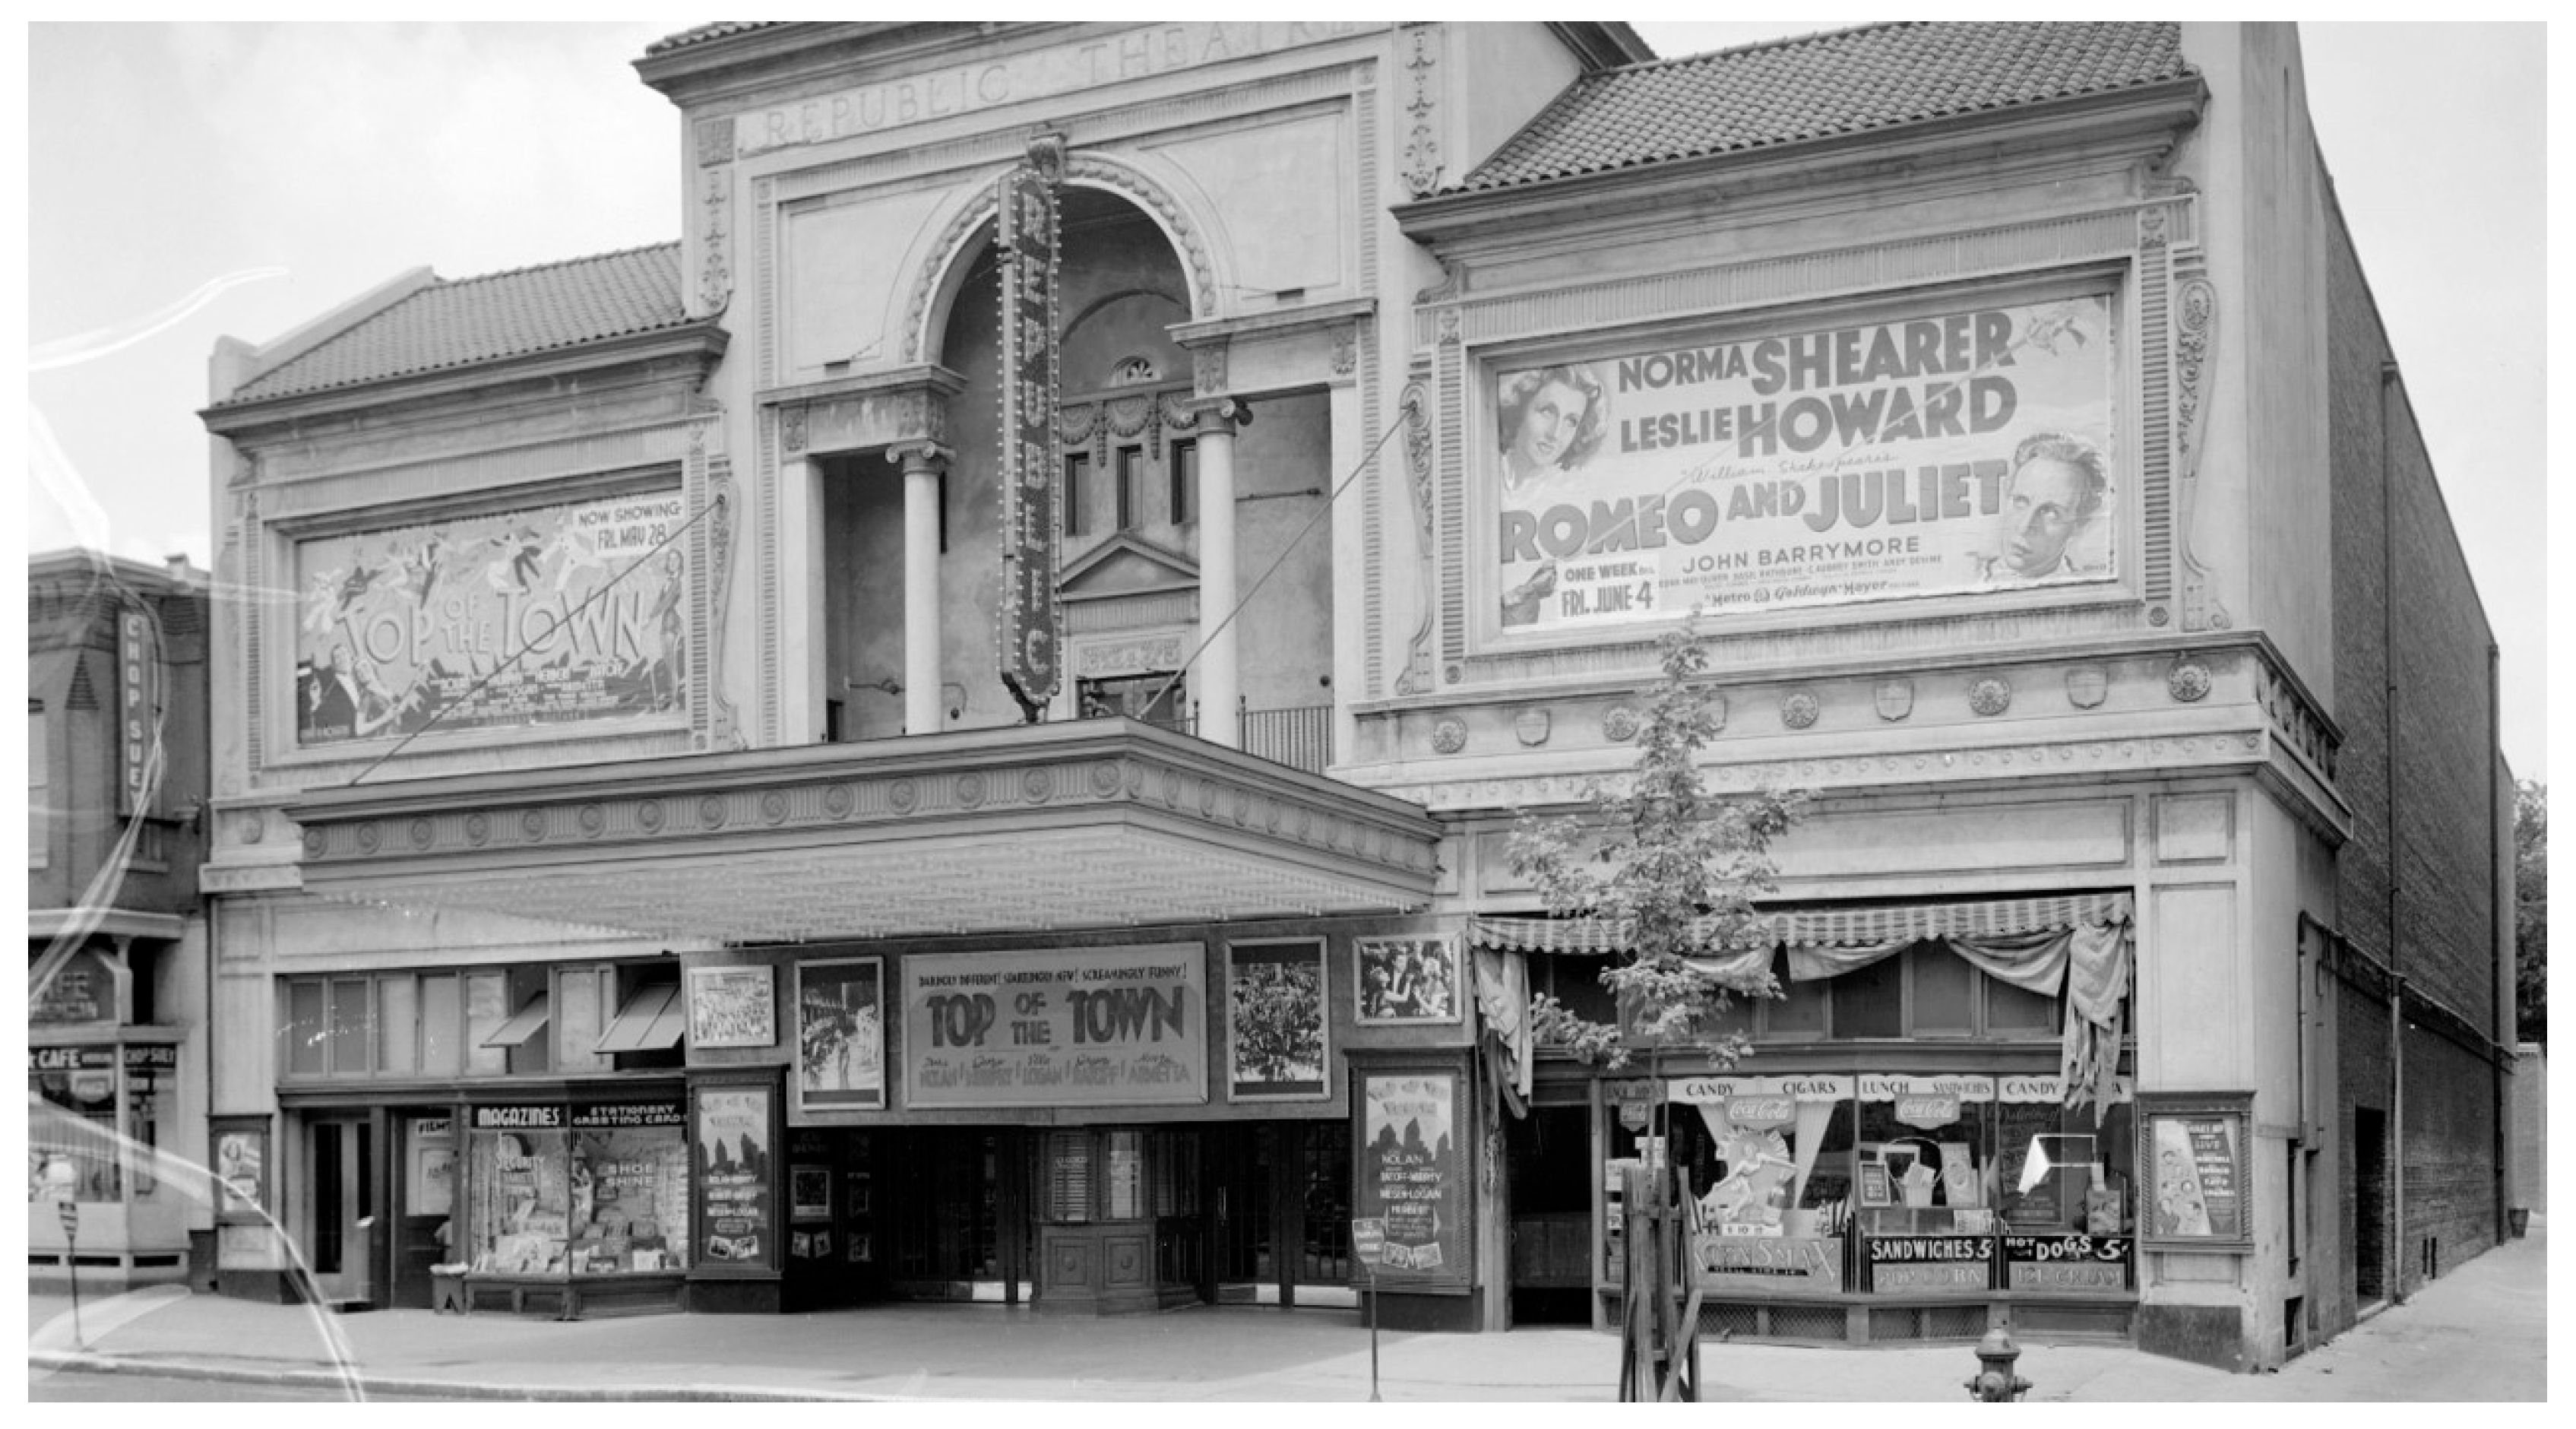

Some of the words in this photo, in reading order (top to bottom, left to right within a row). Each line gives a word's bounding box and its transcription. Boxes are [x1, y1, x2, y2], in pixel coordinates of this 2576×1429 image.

[767, 62, 1009, 147] REPUBLIC
[1619, 344, 1748, 394] NORMA
[1751, 310, 2017, 396] SHEARER
[1620, 406, 1733, 454] LESLIE
[1738, 375, 2017, 459] HOWARD
[1021, 190, 1050, 676] REPUBLIC
[578, 511, 609, 527] NOW
[614, 500, 682, 523] SHOWING
[1500, 489, 1719, 564] ROMEO
[1726, 480, 1806, 521] AND
[1802, 458, 2009, 533] JULIET
[620, 526, 646, 547] MAY
[648, 523, 666, 546] 28
[1682, 550, 1748, 574] JOHN
[1758, 535, 1920, 566] BARRYMORE
[1565, 568, 1596, 582] ONE
[1600, 561, 1638, 578] WEEK
[444, 595, 479, 620] OF
[1562, 587, 1590, 618] FRI.
[1593, 584, 1632, 614] JUNE
[1636, 581, 1654, 611] 4
[1711, 592, 1751, 607] Metro
[334, 604, 435, 667] TOP
[496, 587, 644, 660] TOWN
[443, 622, 491, 653] THE
[126, 617, 141, 707] CHOP
[128, 720, 142, 813] SUEY
[1082, 966, 1145, 981] SCREAMINGLY
[1148, 962, 1187, 980] FUNNY!
[1014, 992, 1046, 1016] OF
[1065, 986, 1185, 1044] TOWN
[926, 993, 996, 1048] TOP
[1011, 1020, 1051, 1046] THE
[38, 1049, 81, 1069] CAFE
[1686, 1082, 1735, 1096] CANDY
[1783, 1081, 1837, 1095] CIGARS
[1862, 1082, 1909, 1095] LUNCH
[2006, 1082, 2059, 1095] CANDY
[477, 1107, 560, 1126] MAGAZINES
[573, 1114, 641, 1126] GREETING
[590, 1104, 676, 1117] STATIONERY
[1729, 1101, 1788, 1120] Coca-Cola
[607, 1163, 653, 1176] SHOE
[1381, 1154, 1423, 1165] NOLAN
[605, 1176, 653, 1187] SHINE
[1872, 1239, 1973, 1260] SANDWICHES
[2007, 1237, 2036, 1247] HOT
[2036, 1235, 2091, 1260] DOGS
